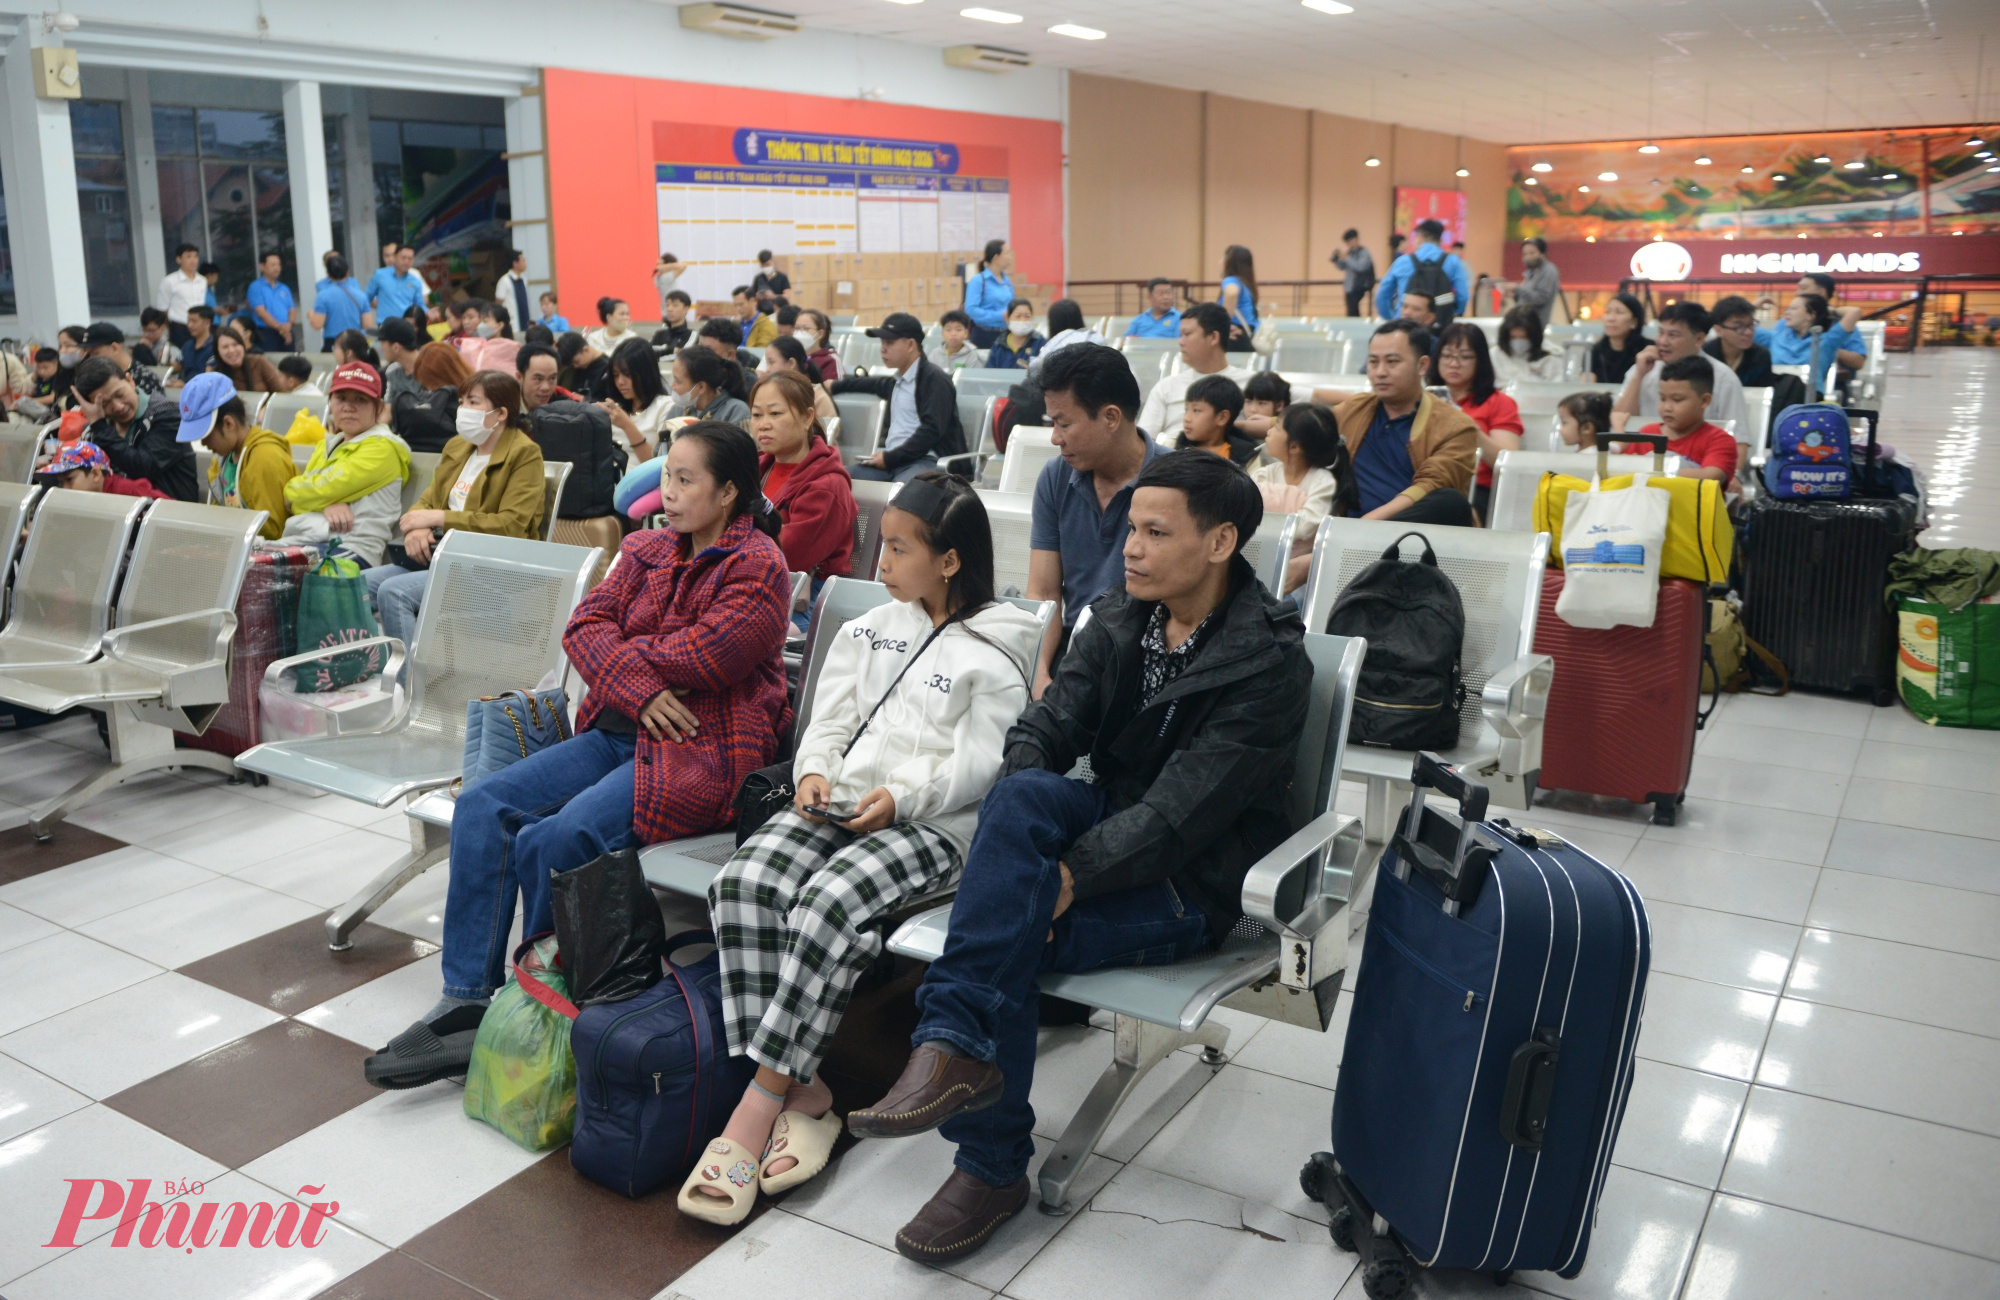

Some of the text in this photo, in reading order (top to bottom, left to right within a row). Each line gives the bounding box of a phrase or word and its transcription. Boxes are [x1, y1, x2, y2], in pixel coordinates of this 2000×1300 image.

[1720, 252, 1920, 274] HIGHLANDS
[1791, 471, 1824, 482] NOW
[853, 626, 908, 653] baance
